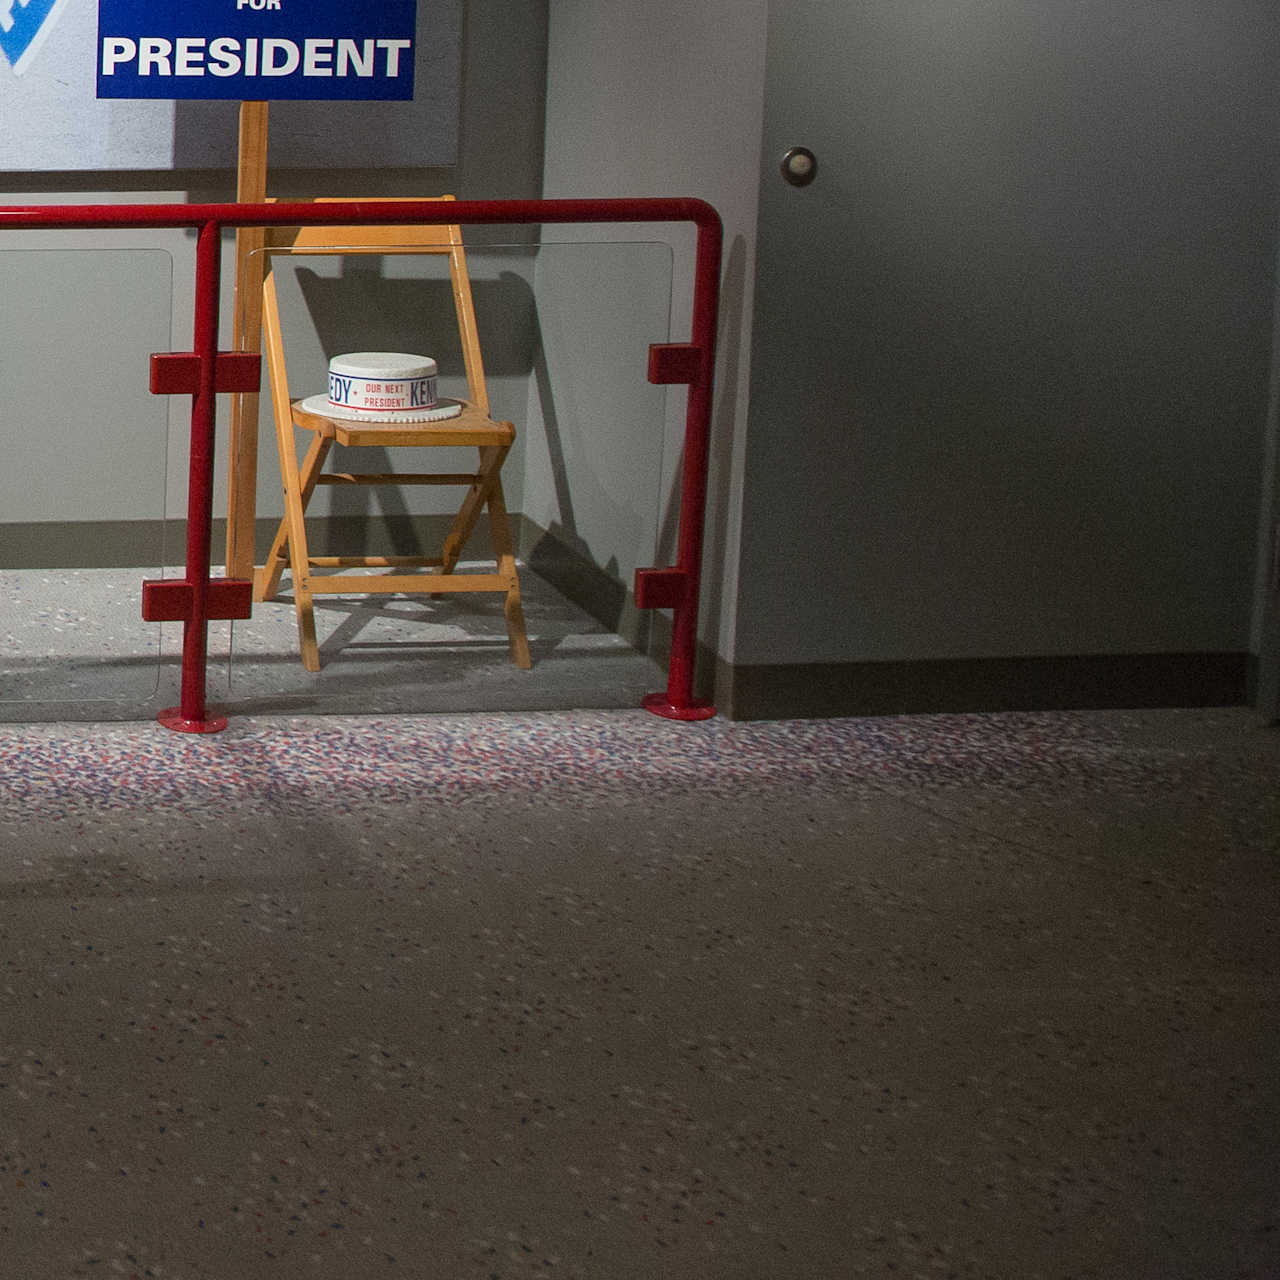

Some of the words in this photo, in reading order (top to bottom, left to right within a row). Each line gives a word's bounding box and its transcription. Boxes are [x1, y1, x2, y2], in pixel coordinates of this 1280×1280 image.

[101, 37, 411, 78] PRESIDENT
[365, 383, 382, 394] OUR
[384, 383, 404, 395] NEXT
[364, 396, 406, 408] PRESIDENT
